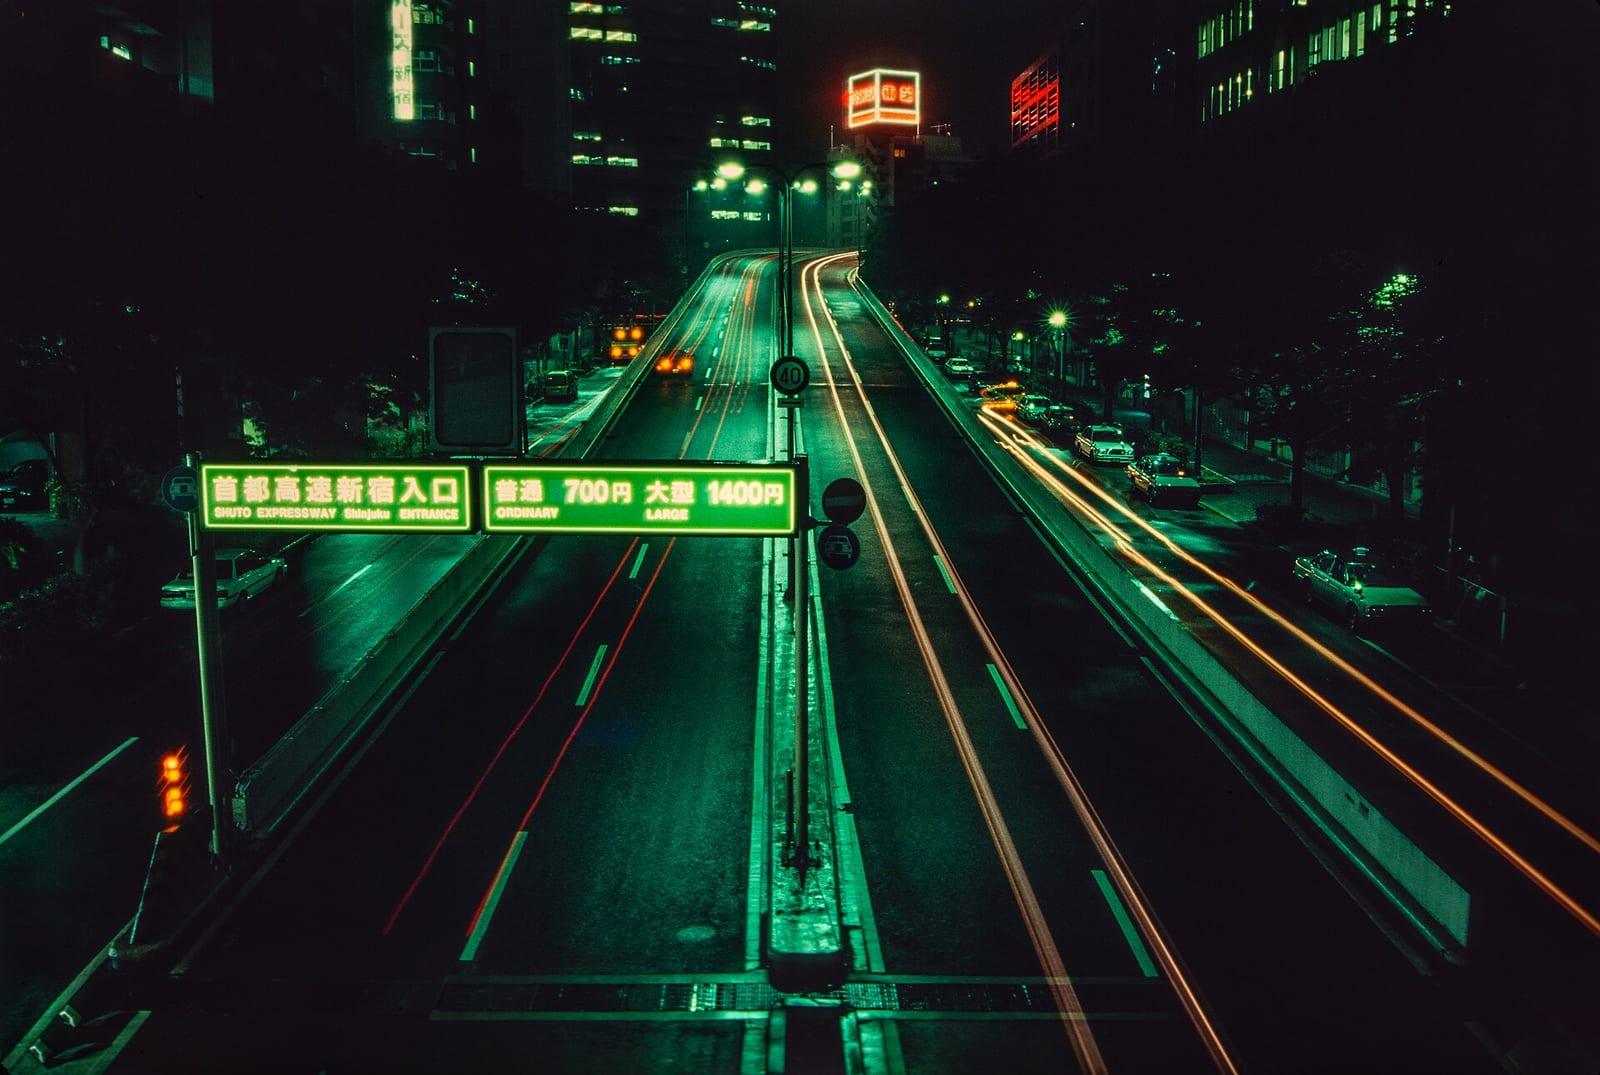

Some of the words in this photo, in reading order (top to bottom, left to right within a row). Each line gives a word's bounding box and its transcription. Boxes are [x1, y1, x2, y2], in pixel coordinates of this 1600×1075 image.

[779, 367, 800, 384] 40
[212, 476, 459, 503] 首都高速新宿入口
[495, 479, 543, 502] 普通
[564, 479, 632, 504] 700円
[645, 480, 695, 504] 大型
[707, 481, 784, 505] 1400円
[214, 507, 252, 518] SHUTO
[256, 507, 337, 519] EXPRESSWAY
[343, 508, 391, 521] Shinjuku
[399, 508, 459, 520] ENTRANCE
[495, 507, 559, 519] ORDINARY
[645, 508, 689, 520] LARGE
